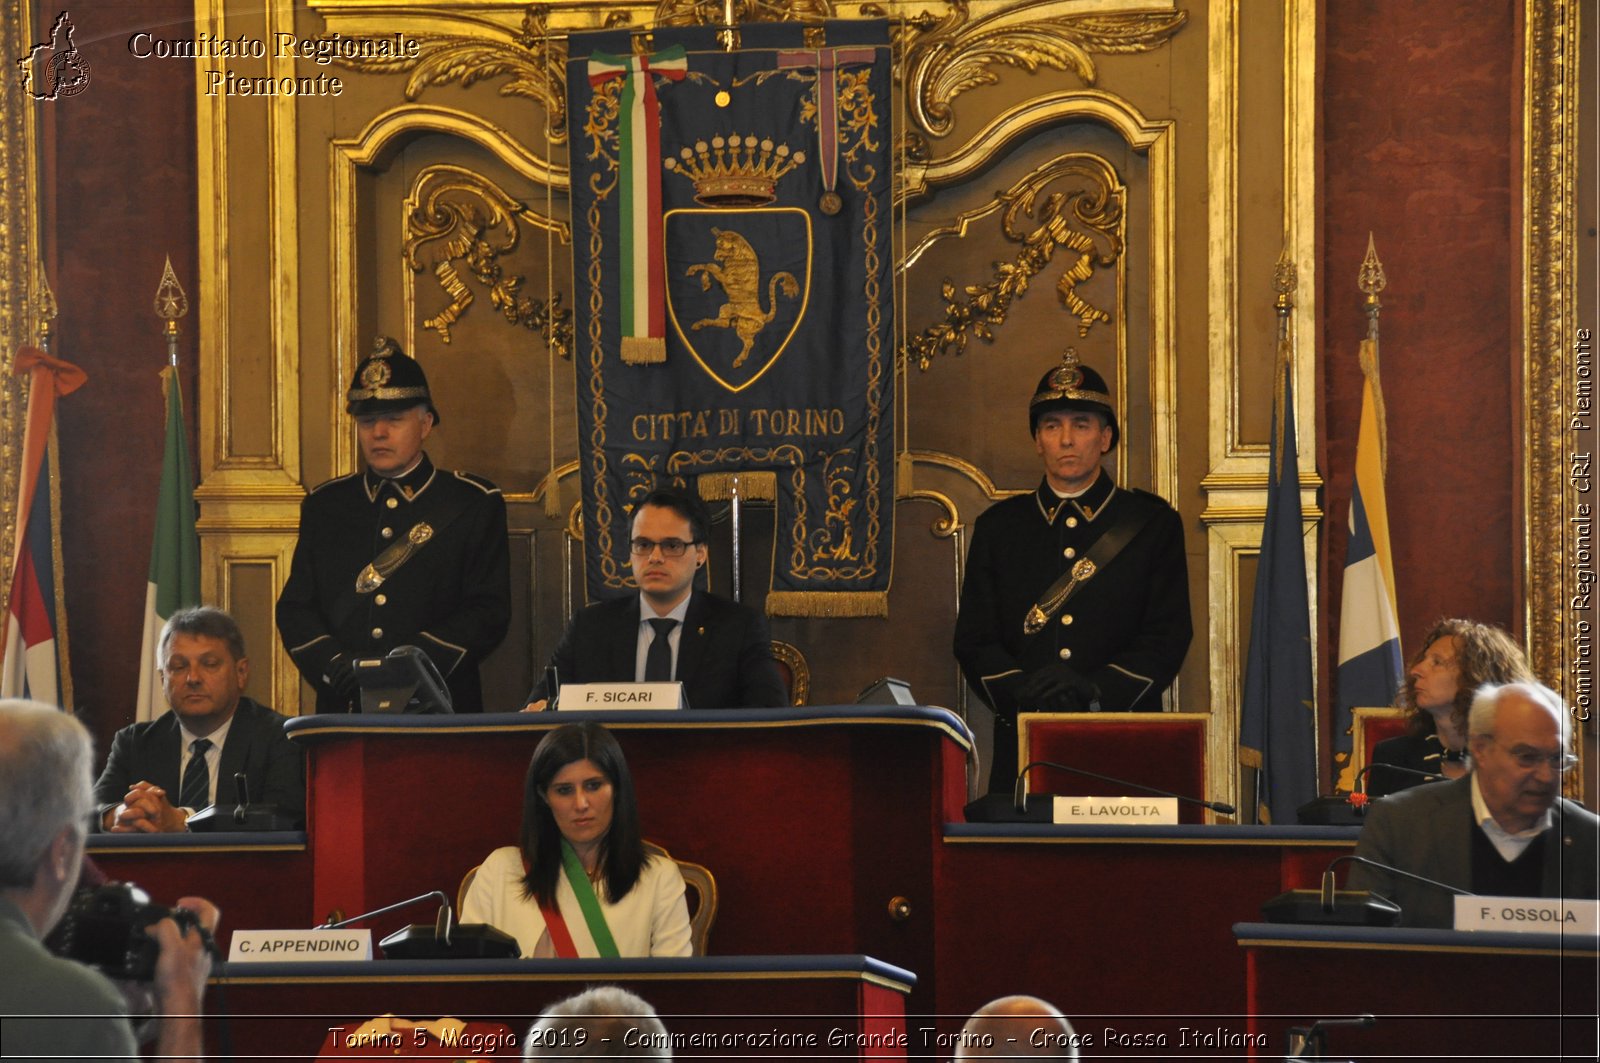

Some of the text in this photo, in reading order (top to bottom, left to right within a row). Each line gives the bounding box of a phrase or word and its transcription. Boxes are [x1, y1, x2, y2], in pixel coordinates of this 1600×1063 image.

[719, 408, 740, 436] DI
[750, 408, 844, 436] TORINO
[586, 692, 652, 702] F. SICARI
[1071, 805, 1160, 816] E. LAVOLTA
[1480, 907, 1577, 923] F. OSSOLA
[239, 939, 360, 952] C. APPENDINO
